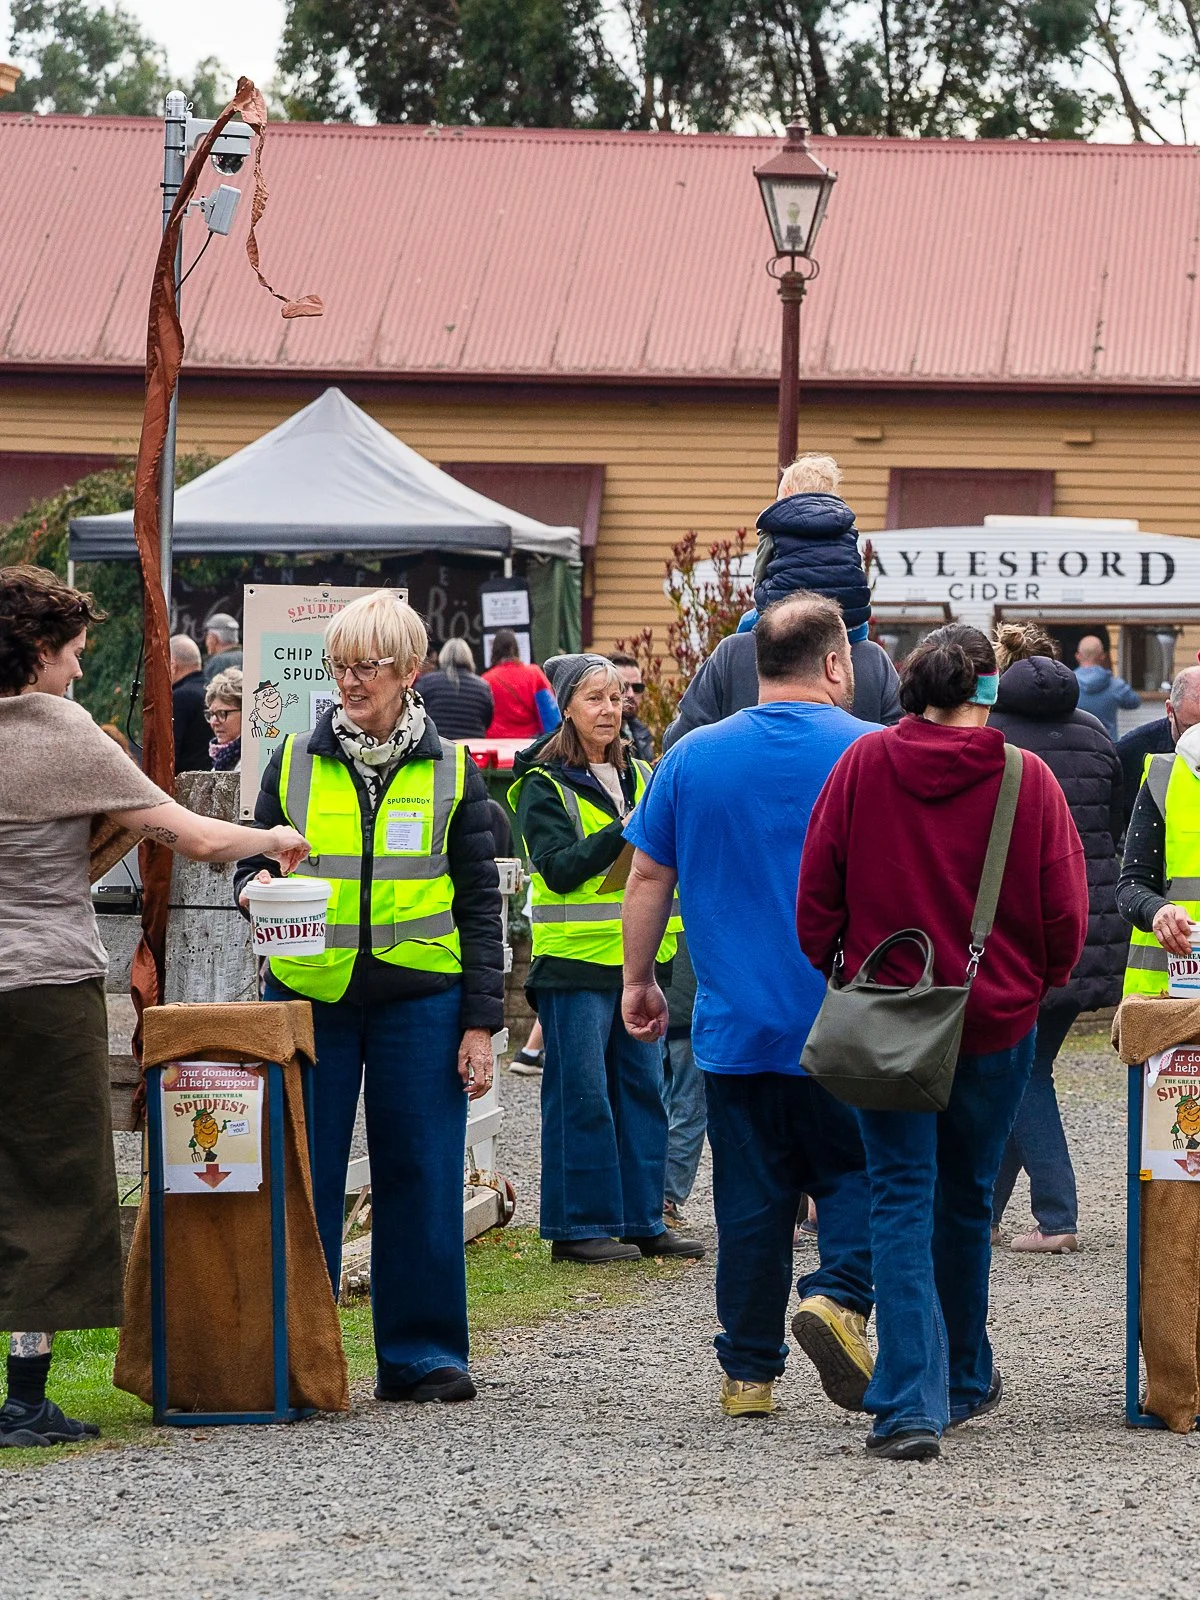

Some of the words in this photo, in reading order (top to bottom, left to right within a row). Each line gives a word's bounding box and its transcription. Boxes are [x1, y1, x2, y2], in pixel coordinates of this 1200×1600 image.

[870, 551, 1176, 586] AYLESFORD
[949, 583, 1040, 600] CIDER
[274, 648, 313, 661] CHIP
[284, 668, 330, 681] SPUD
[387, 797, 431, 805] SPUDBUDDY
[256, 923, 326, 945] SPUDFES
[202, 1067, 248, 1078] donation
[1175, 1063, 1198, 1075] help
[189, 1078, 212, 1089] help
[214, 1079, 256, 1089] support
[173, 1099, 248, 1117] SPUDFEST
